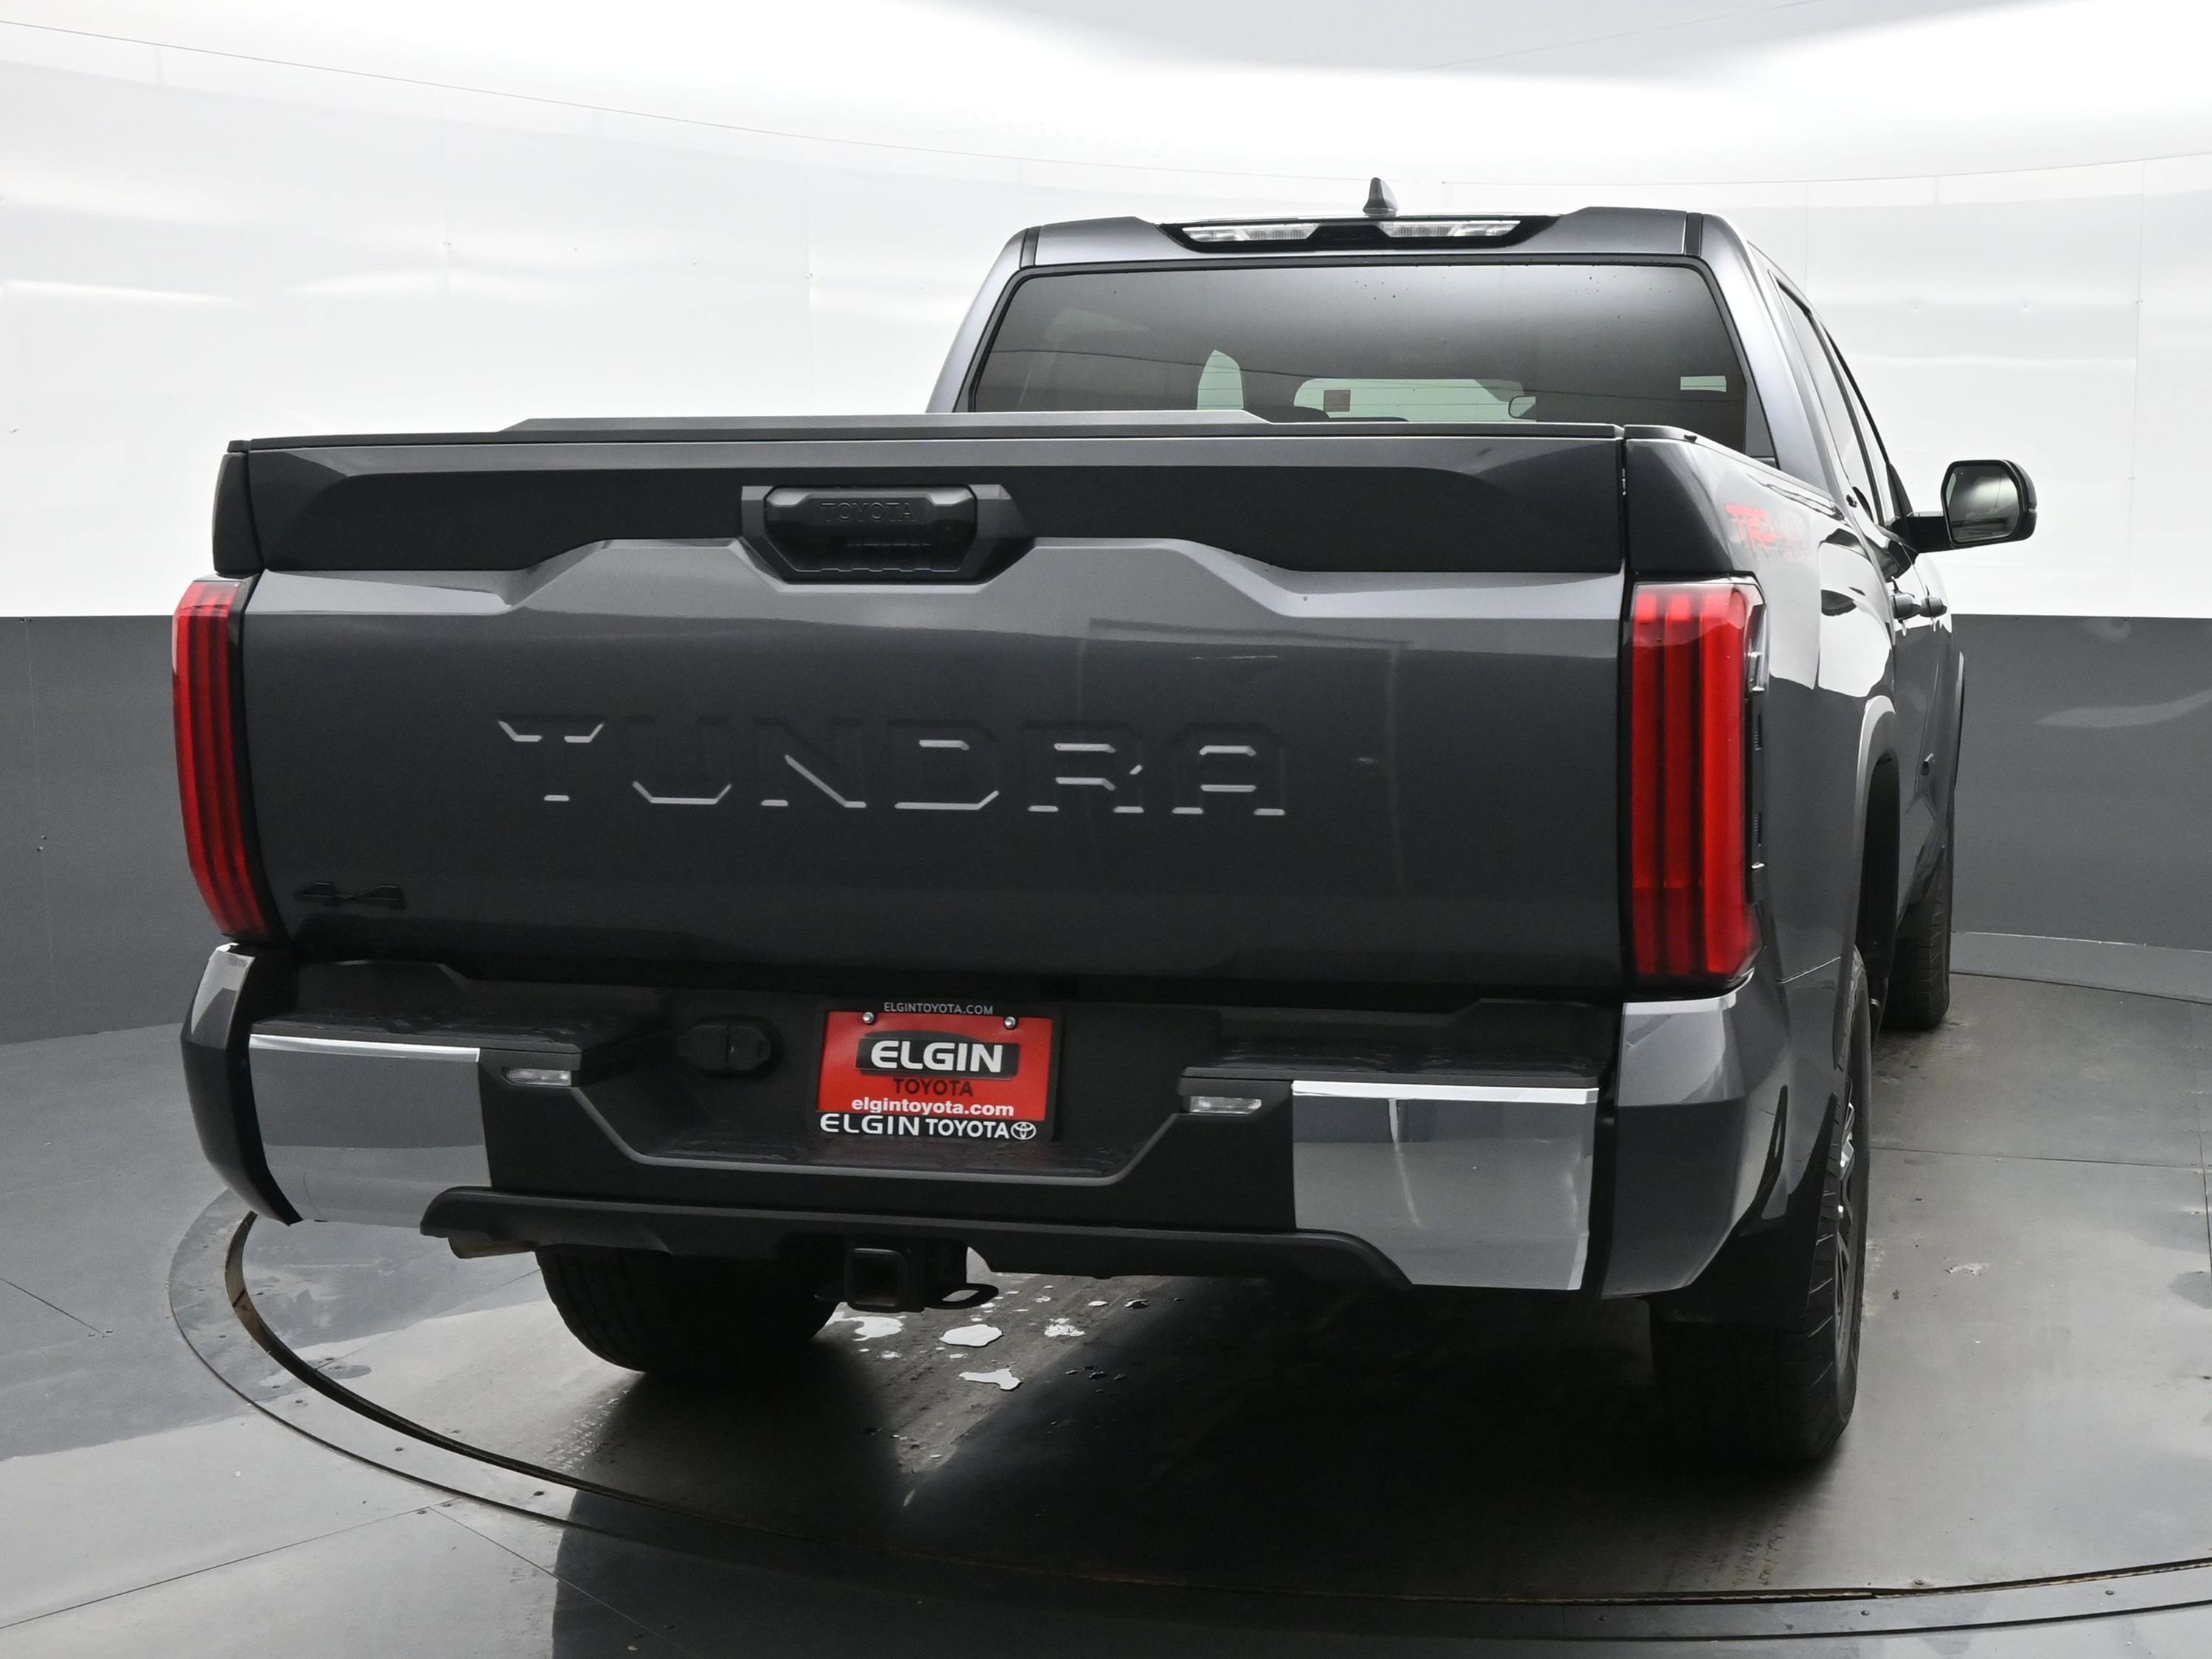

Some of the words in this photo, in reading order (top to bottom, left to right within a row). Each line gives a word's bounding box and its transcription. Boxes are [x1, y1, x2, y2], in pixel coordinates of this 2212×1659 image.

[820, 502, 918, 524] TOYOTA
[498, 715, 1286, 816] TUNDRA
[883, 1002, 994, 1015] ELGINTOYOTA.COM
[871, 1040, 1003, 1073] ELGIN
[893, 1077, 973, 1096] TOYOTA
[851, 1097, 1015, 1116] elgintoyota.com
[820, 1113, 920, 1135] ELGIN
[925, 1118, 1009, 1139] TOYOTA
